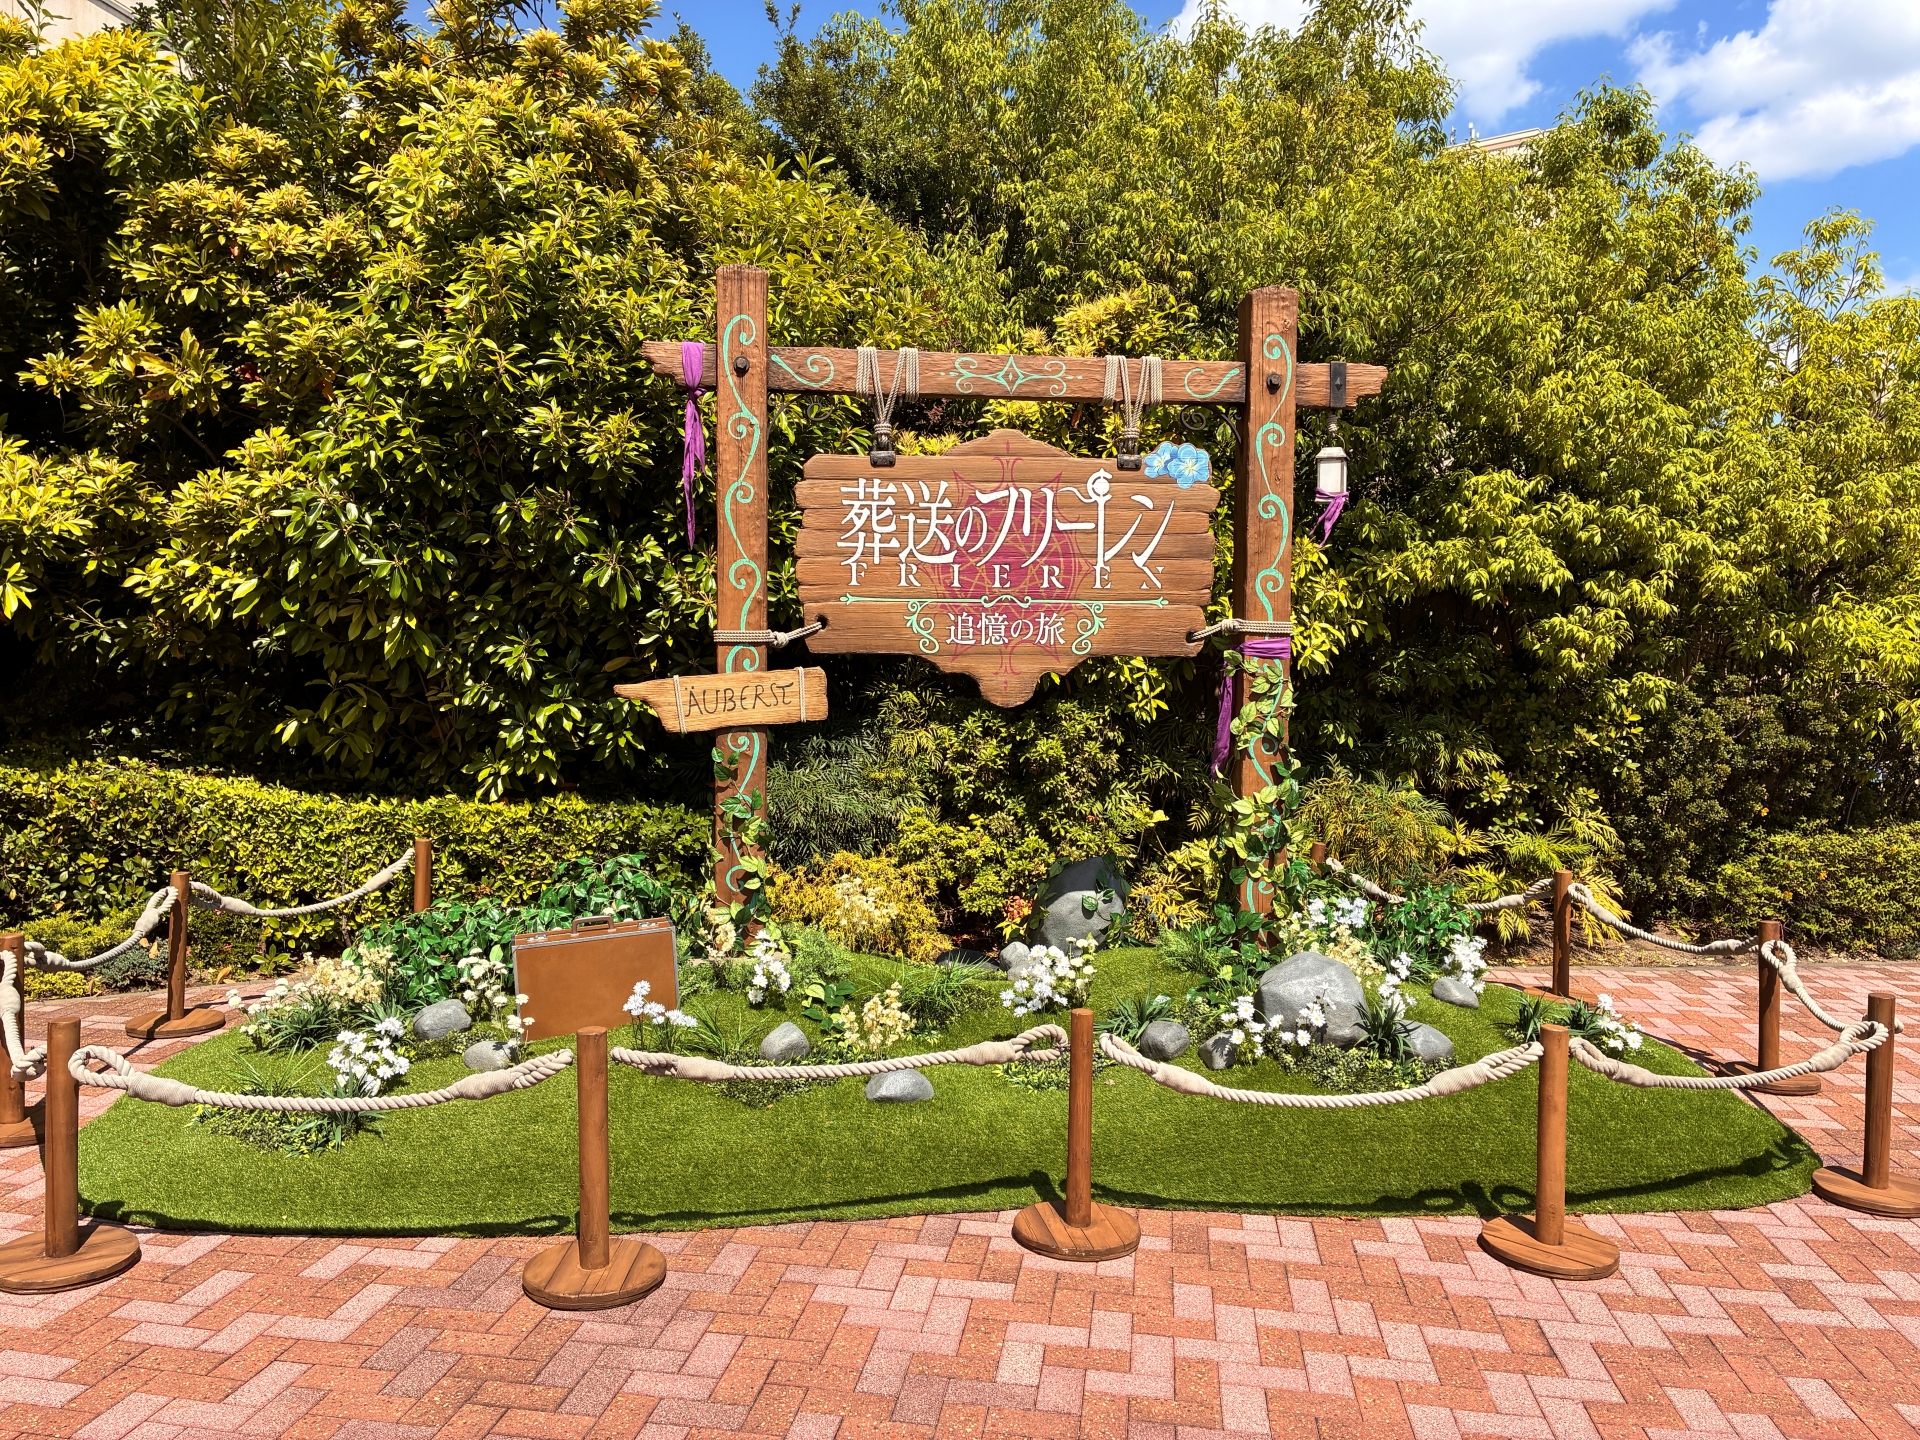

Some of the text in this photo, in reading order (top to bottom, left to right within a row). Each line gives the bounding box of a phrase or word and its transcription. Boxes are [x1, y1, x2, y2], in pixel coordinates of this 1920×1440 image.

[836, 468, 1175, 568] 葬送のフリーレン
[847, 562, 1165, 590] FRIEREN
[945, 611, 1066, 646] 追憶の旅
[684, 681, 794, 717] ÄUBERST
